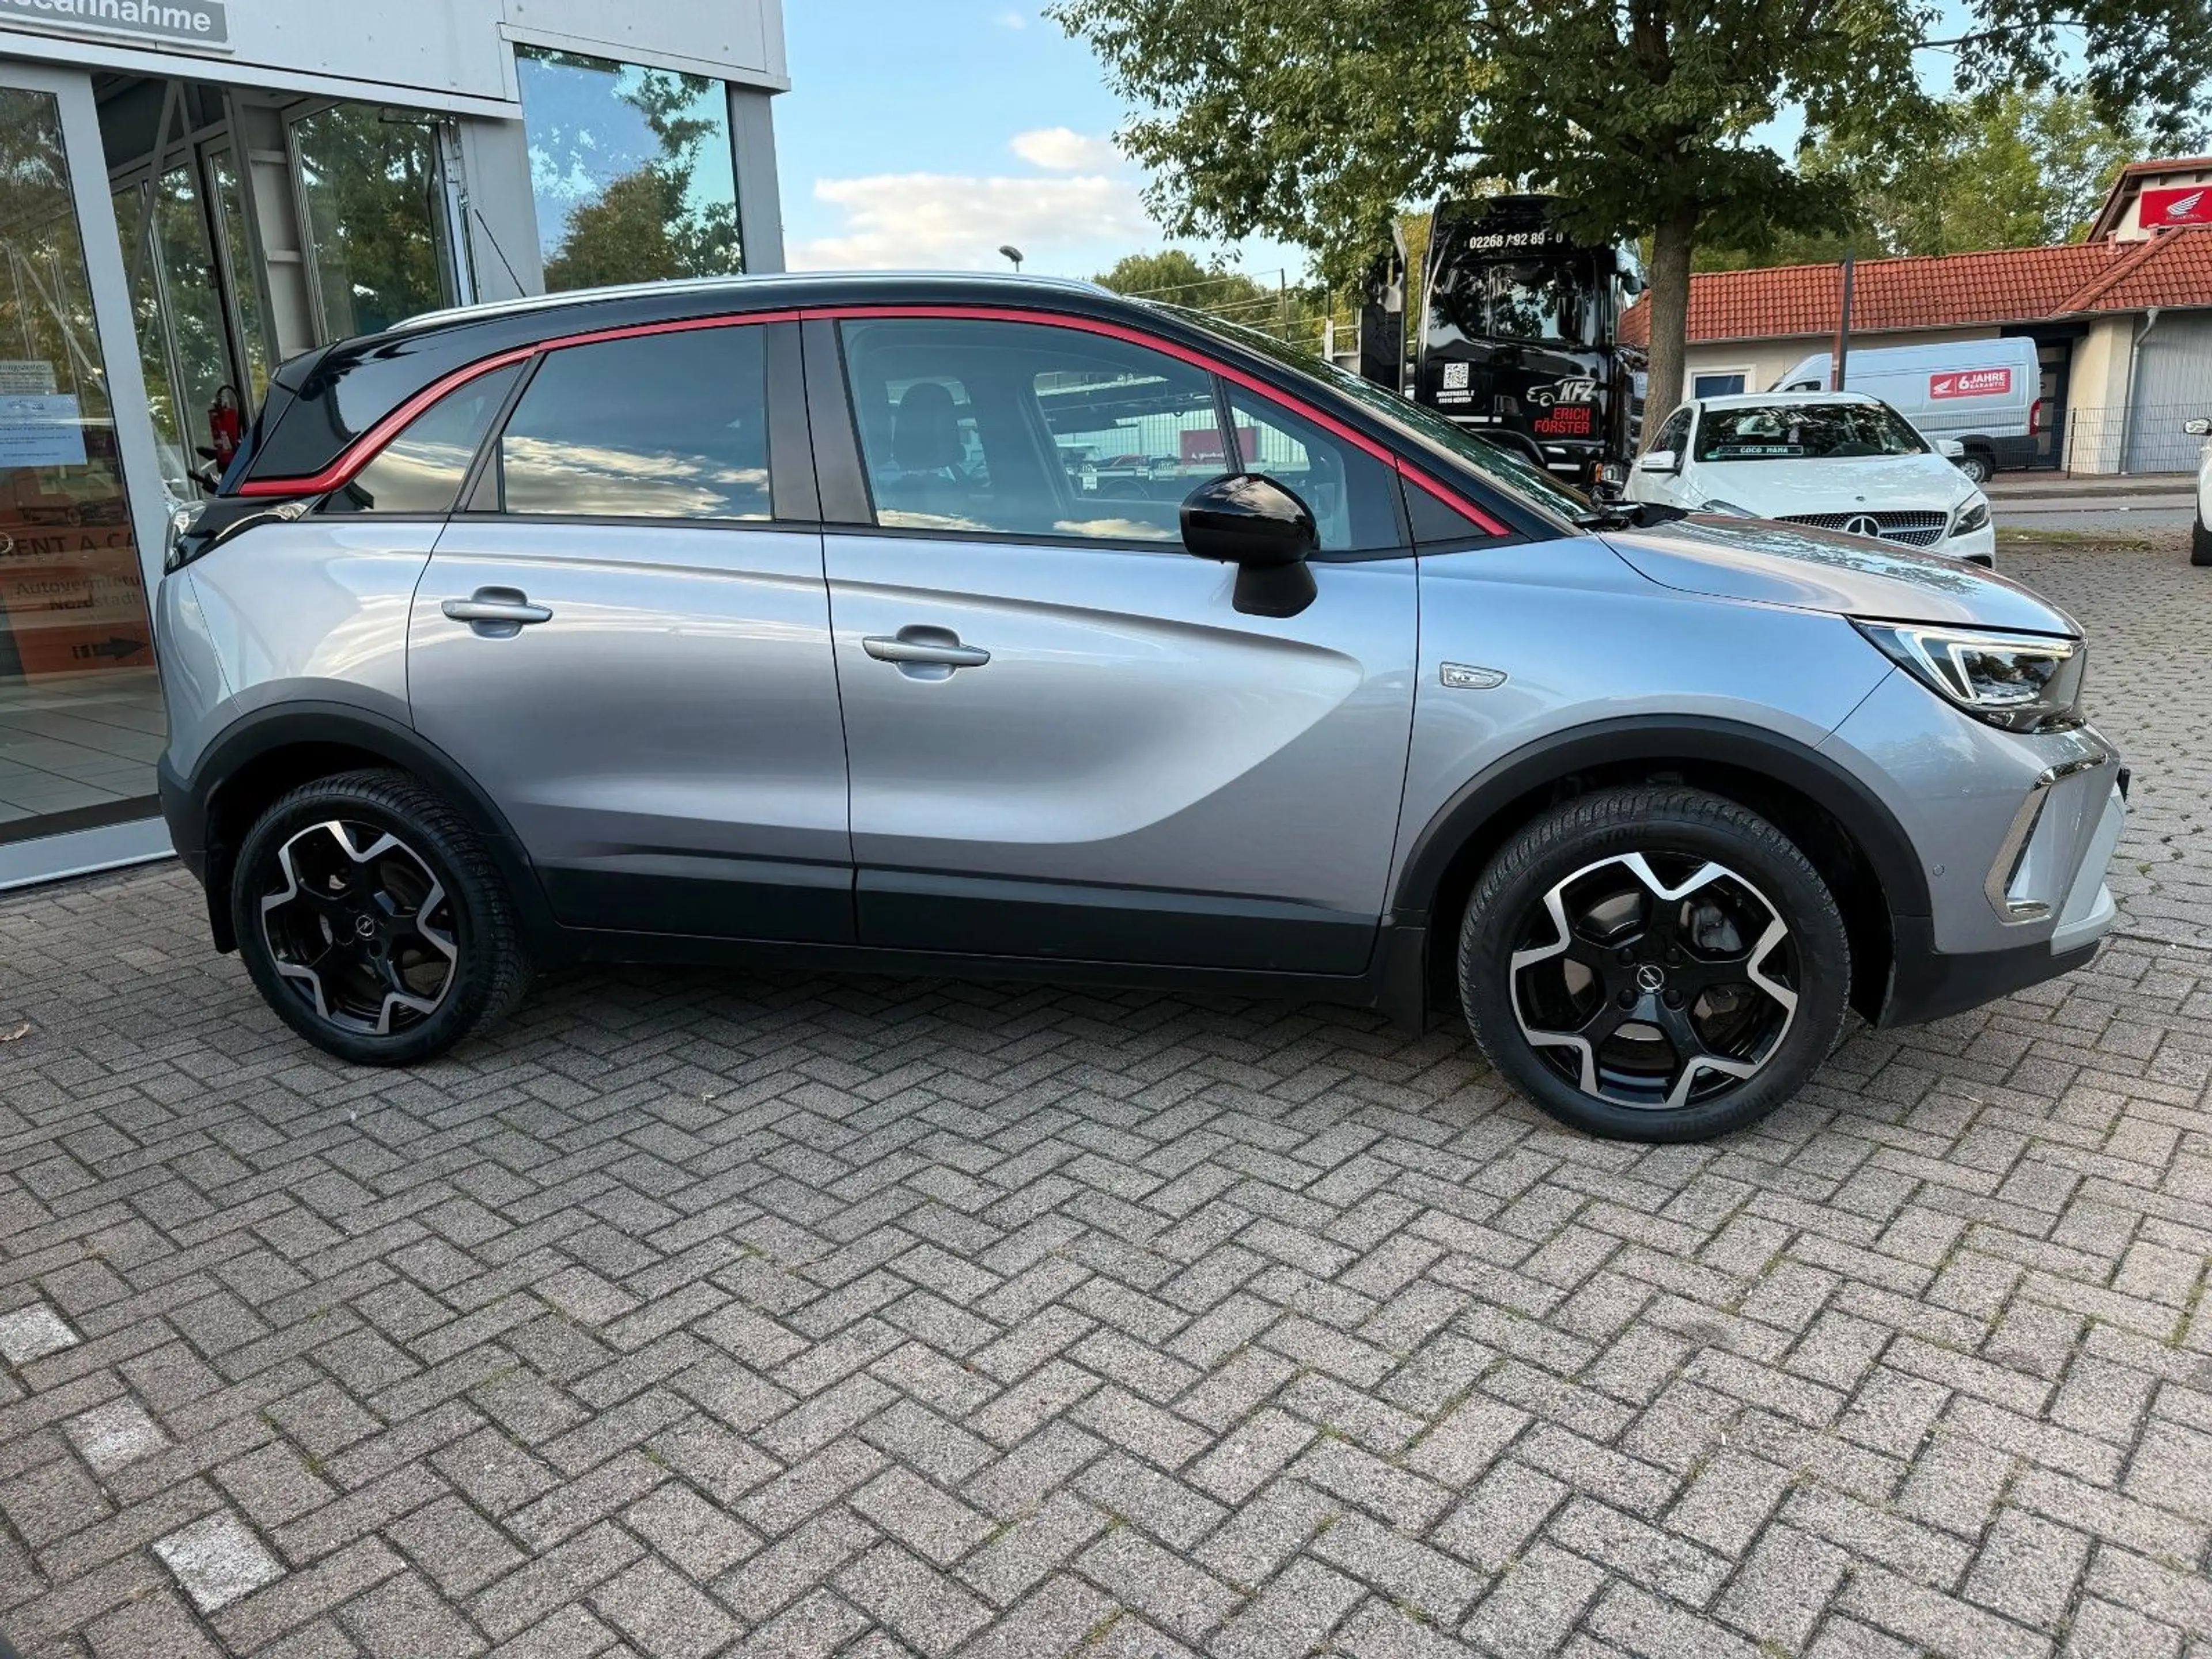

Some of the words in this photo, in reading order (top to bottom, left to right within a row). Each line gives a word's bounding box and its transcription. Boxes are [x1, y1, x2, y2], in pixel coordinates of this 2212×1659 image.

[0, 0, 211, 32] annahme
[1469, 234, 1503, 249] 02268
[1512, 233, 1528, 246] 92
[1530, 232, 1545, 245] 89
[1958, 375, 1970, 389] 6
[1970, 372, 2008, 384] JAHRE
[1559, 381, 1596, 402] KFZ
[1553, 407, 1590, 421] ERICH
[1534, 418, 1590, 434] FÖRSTER
[79, 535, 97, 551] A
